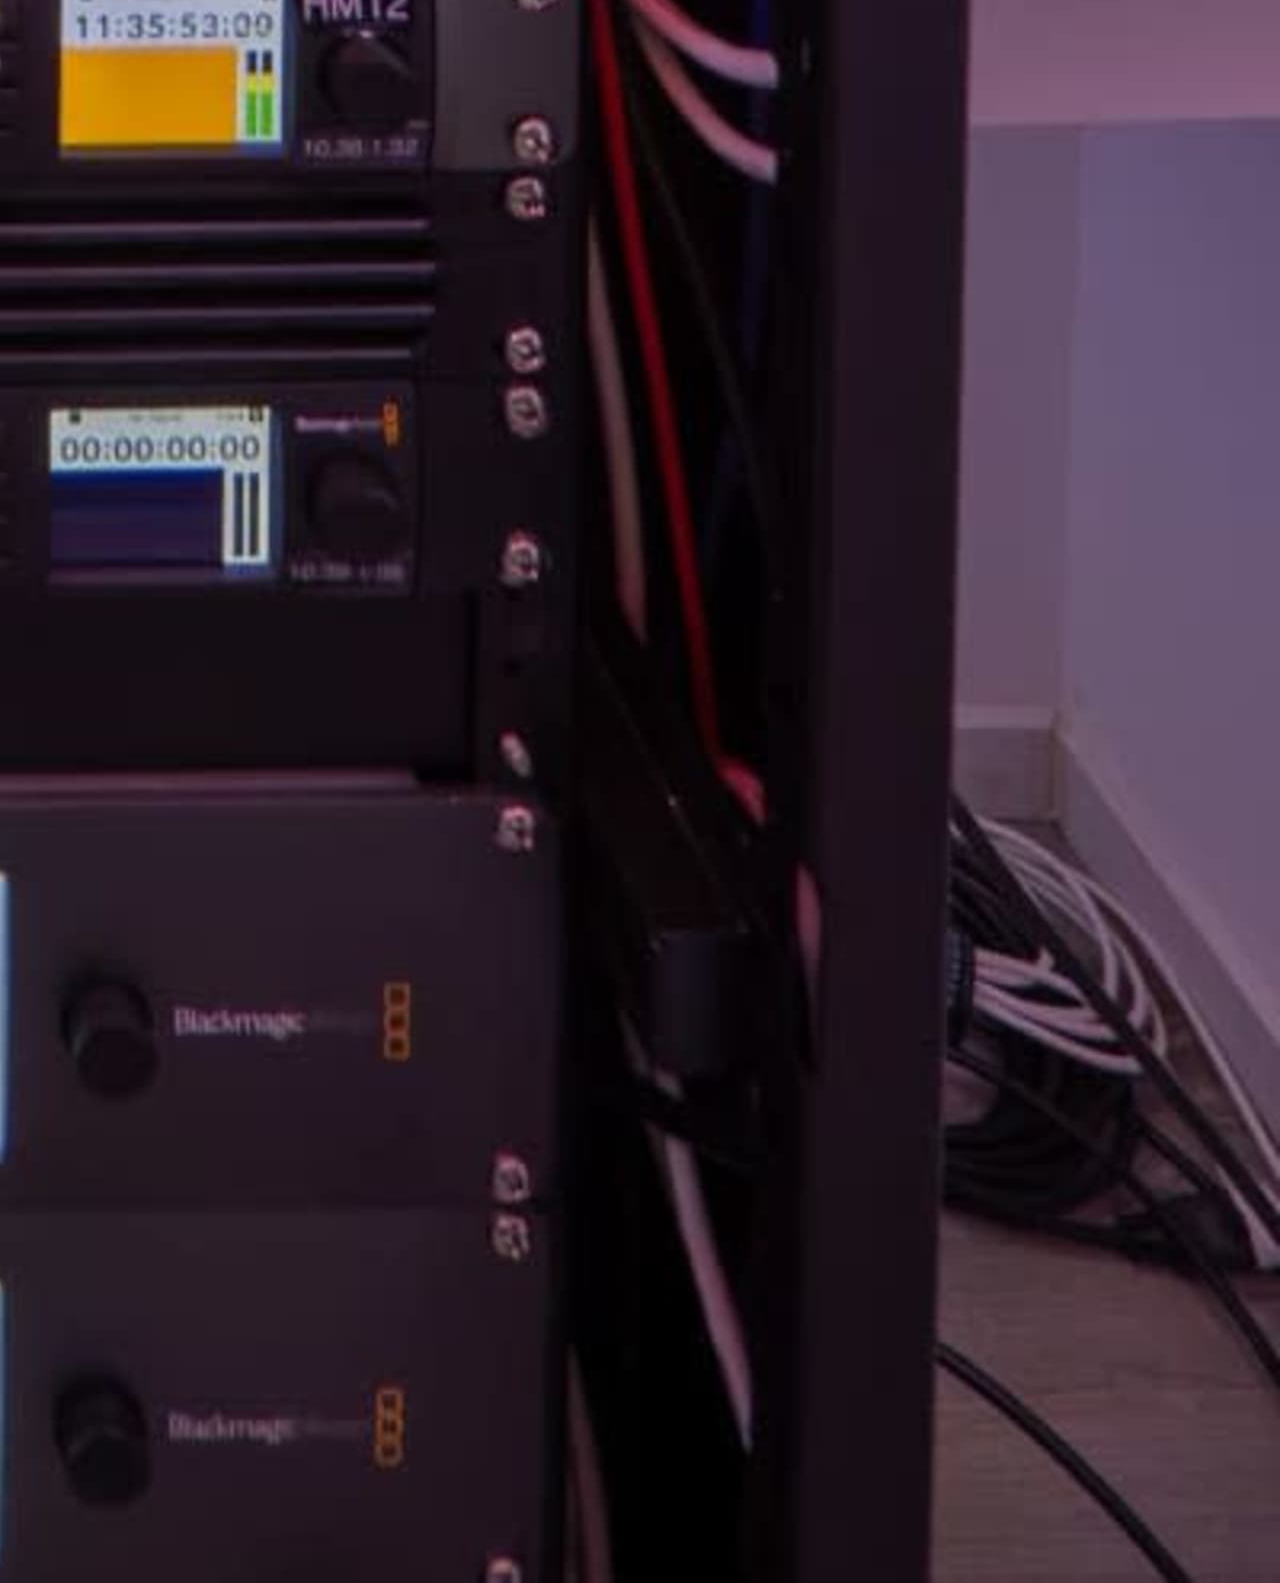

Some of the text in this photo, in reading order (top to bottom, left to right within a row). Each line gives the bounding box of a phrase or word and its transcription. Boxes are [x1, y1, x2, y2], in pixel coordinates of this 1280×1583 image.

[58, 434, 263, 463] 00:00:00:00
[172, 1005, 306, 1039] Blackmagic
[166, 1412, 296, 1444] Blackmagic
